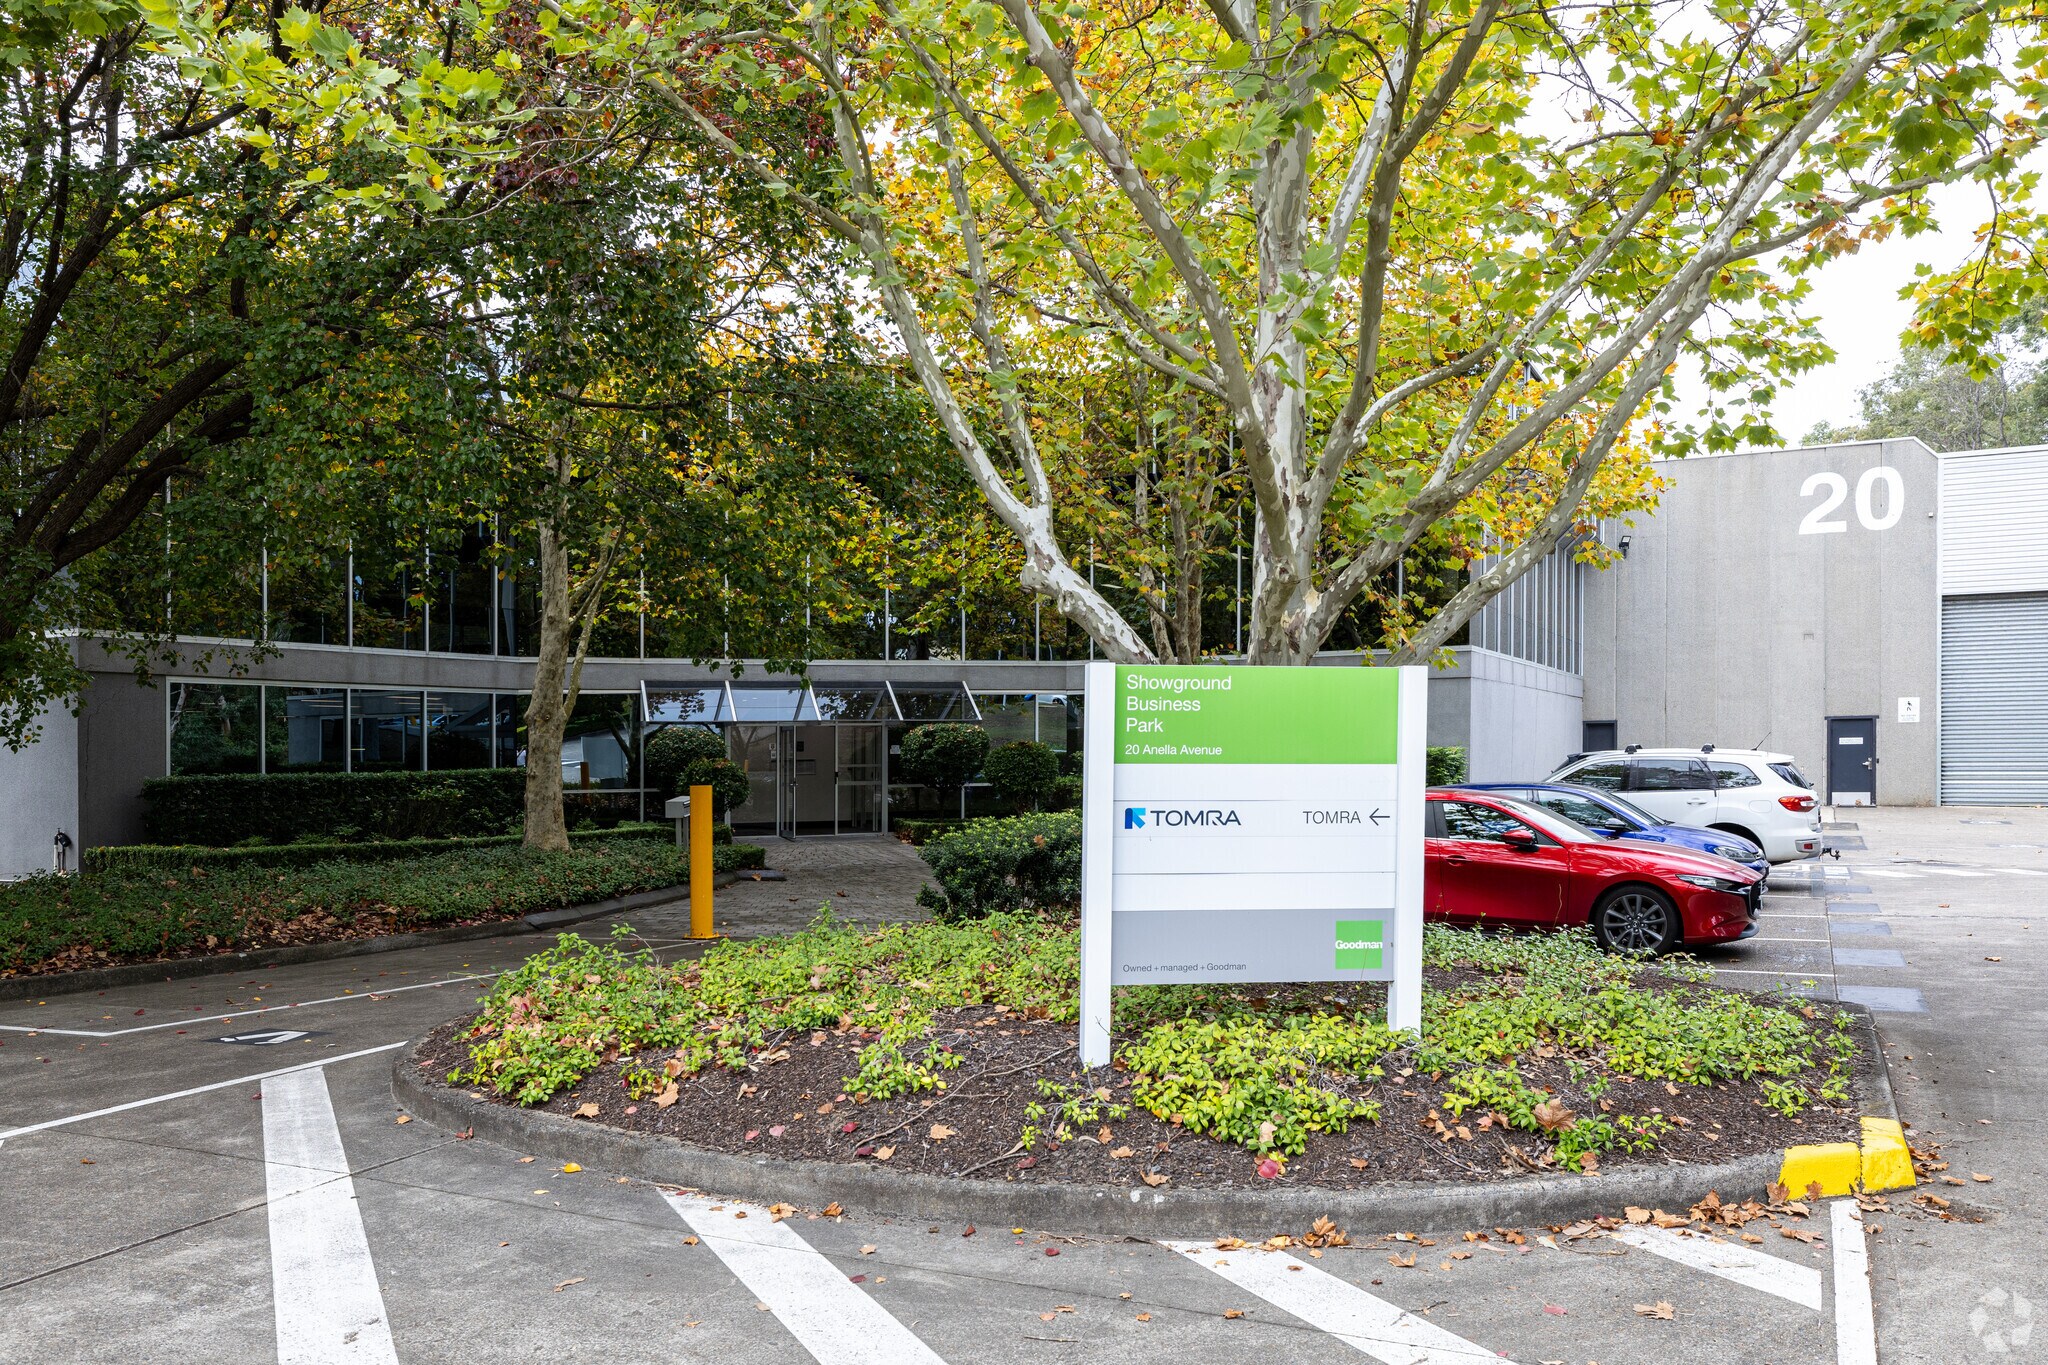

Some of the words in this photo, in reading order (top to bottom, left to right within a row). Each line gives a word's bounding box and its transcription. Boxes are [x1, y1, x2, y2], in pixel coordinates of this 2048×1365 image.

[1799, 466, 1905, 535] 20
[1126, 674, 1232, 693] Showground
[1126, 696, 1201, 711] Business
[1126, 718, 1164, 732] Park
[1125, 744, 1140, 755] 20
[1142, 744, 1177, 755] Anella
[1180, 744, 1223, 755] Avenue
[1150, 810, 1242, 826] TOMRA
[1302, 810, 1361, 824] TOMRA
[1335, 940, 1383, 949] Goodman
[1122, 964, 1152, 973] Owned
[1160, 963, 1199, 973] managed
[1206, 962, 1247, 971] Goodman
